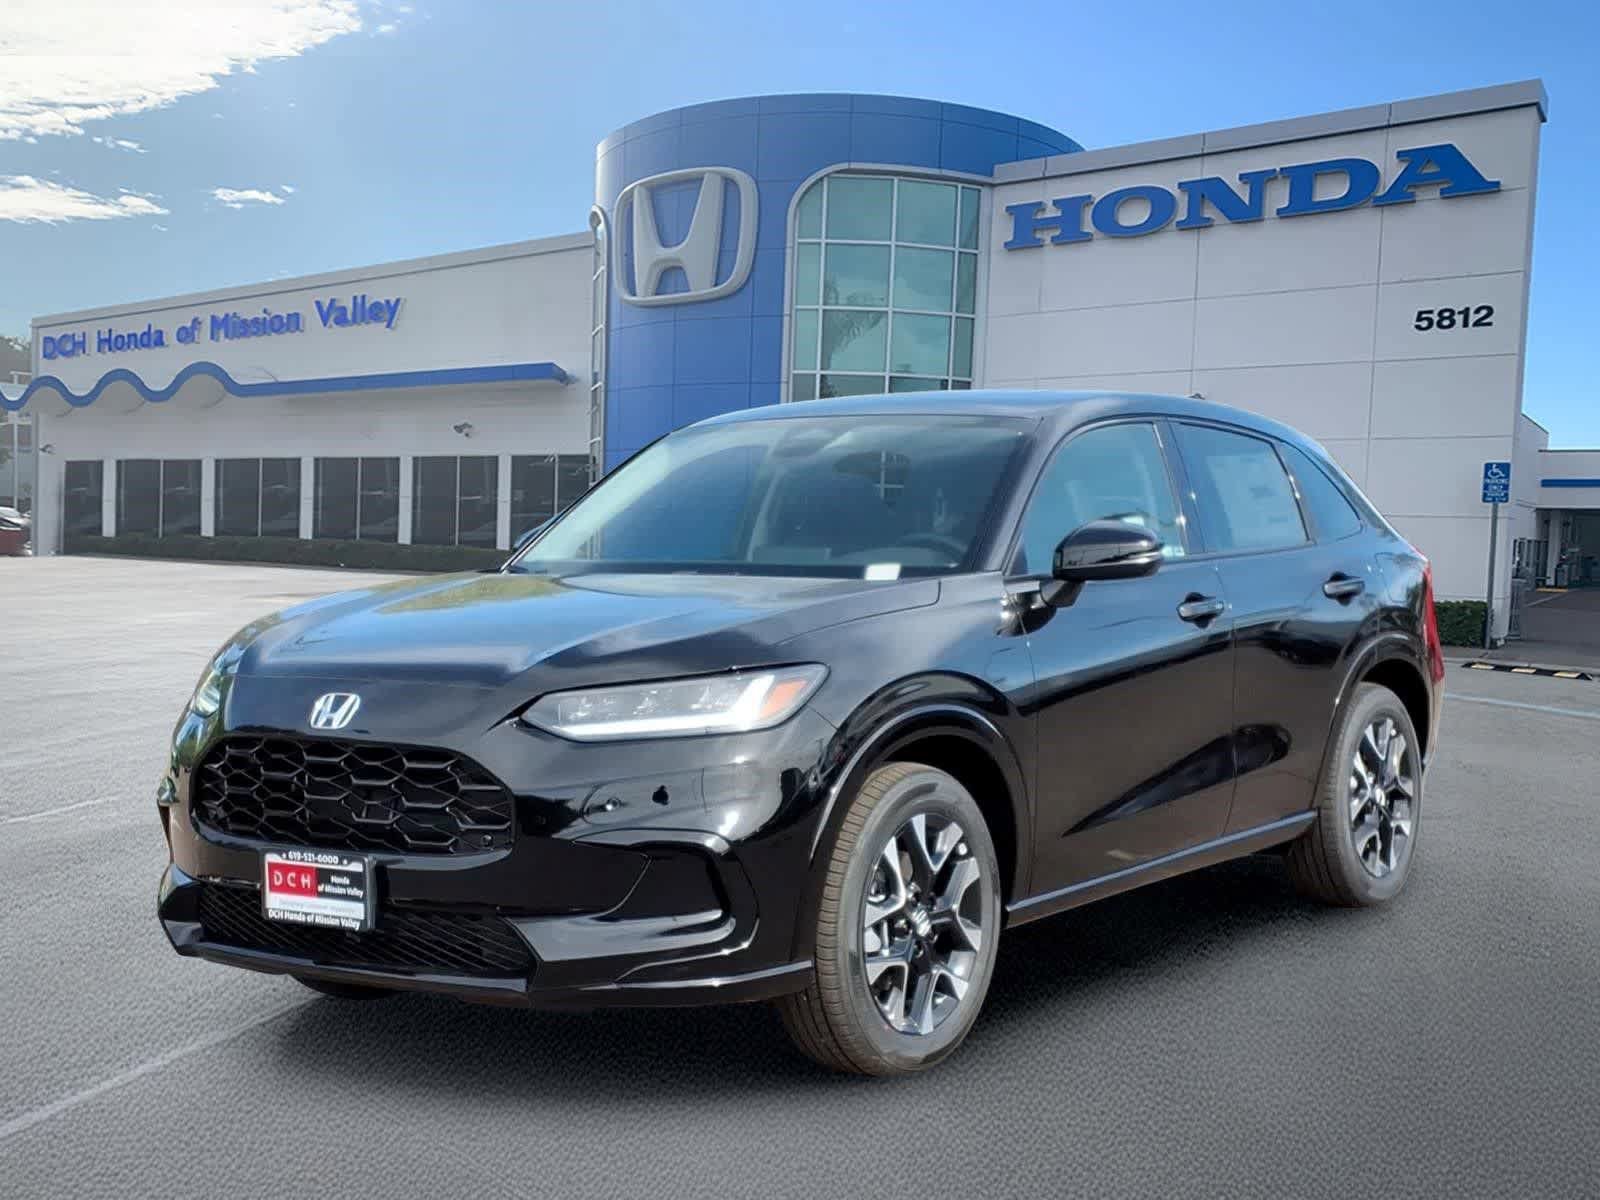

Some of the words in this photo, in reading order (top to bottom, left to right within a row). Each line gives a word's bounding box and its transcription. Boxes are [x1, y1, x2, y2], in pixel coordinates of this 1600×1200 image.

[1004, 143, 1501, 250] HONDA
[42, 331, 87, 361] DCH
[97, 323, 165, 353] Honda
[176, 317, 201, 344] of
[210, 308, 302, 341] Mission
[314, 294, 401, 329] Valley
[1413, 304, 1494, 332] 5812
[288, 851, 339, 864] 619-521-6000
[268, 910, 283, 920] DCH
[284, 910, 305, 922] Honda
[307, 913, 315, 922] of
[315, 914, 340, 926] Mission
[341, 918, 360, 931] Valley
